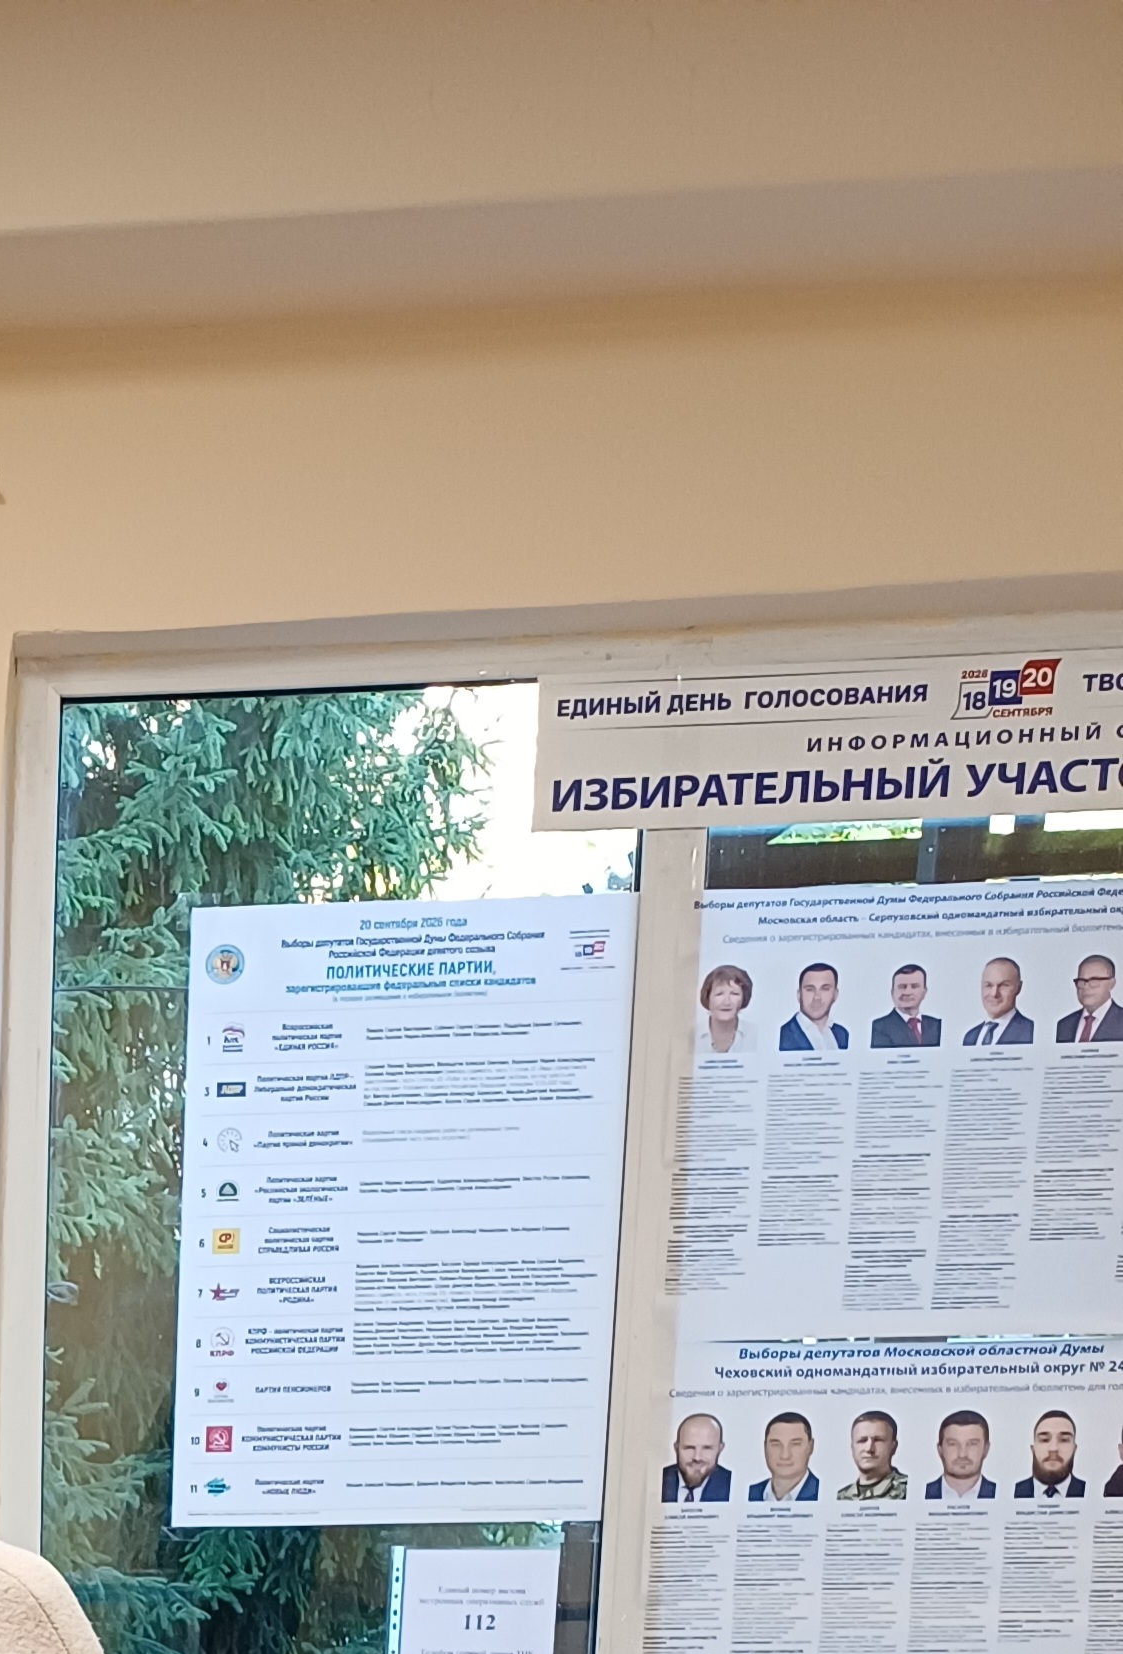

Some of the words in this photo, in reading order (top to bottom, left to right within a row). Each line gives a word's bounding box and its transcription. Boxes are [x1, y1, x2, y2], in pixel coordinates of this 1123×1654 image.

[963, 691, 986, 711] 18
[992, 678, 1017, 699] 19
[1022, 667, 1053, 688] 20
[556, 690, 661, 720] ЕДИНЫЙ
[666, 692, 732, 715] ДЕНЬ
[744, 684, 929, 710] ГОЛОСОВАНИЯ
[992, 706, 1054, 718] СЕНТЯБРЯ
[806, 722, 1102, 753] ИНФОРМАЦИОННЫЙ
[551, 758, 951, 813] ИЗБИРАТЕЛЬНЫЙ
[966, 756, 1123, 798] УЧАСТ
[694, 900, 735, 911] Выборы
[736, 899, 787, 910] депутатов
[360, 919, 371, 931] 20
[326, 962, 435, 980] ПОЛИТИЧЕСКИЕ
[739, 1348, 802, 1361] Выборы
[803, 1347, 880, 1361] депутатов
[883, 1344, 975, 1357] Московской
[979, 1344, 1057, 1356] областной
[1060, 1343, 1105, 1357] Думы
[714, 1365, 793, 1379] Чеховский
[796, 1363, 918, 1379] одномандатный
[921, 1361, 1040, 1377] избирательный
[1043, 1363, 1086, 1375] округ
[1089, 1361, 1105, 1372] №
[465, 1614, 496, 1630] 112
